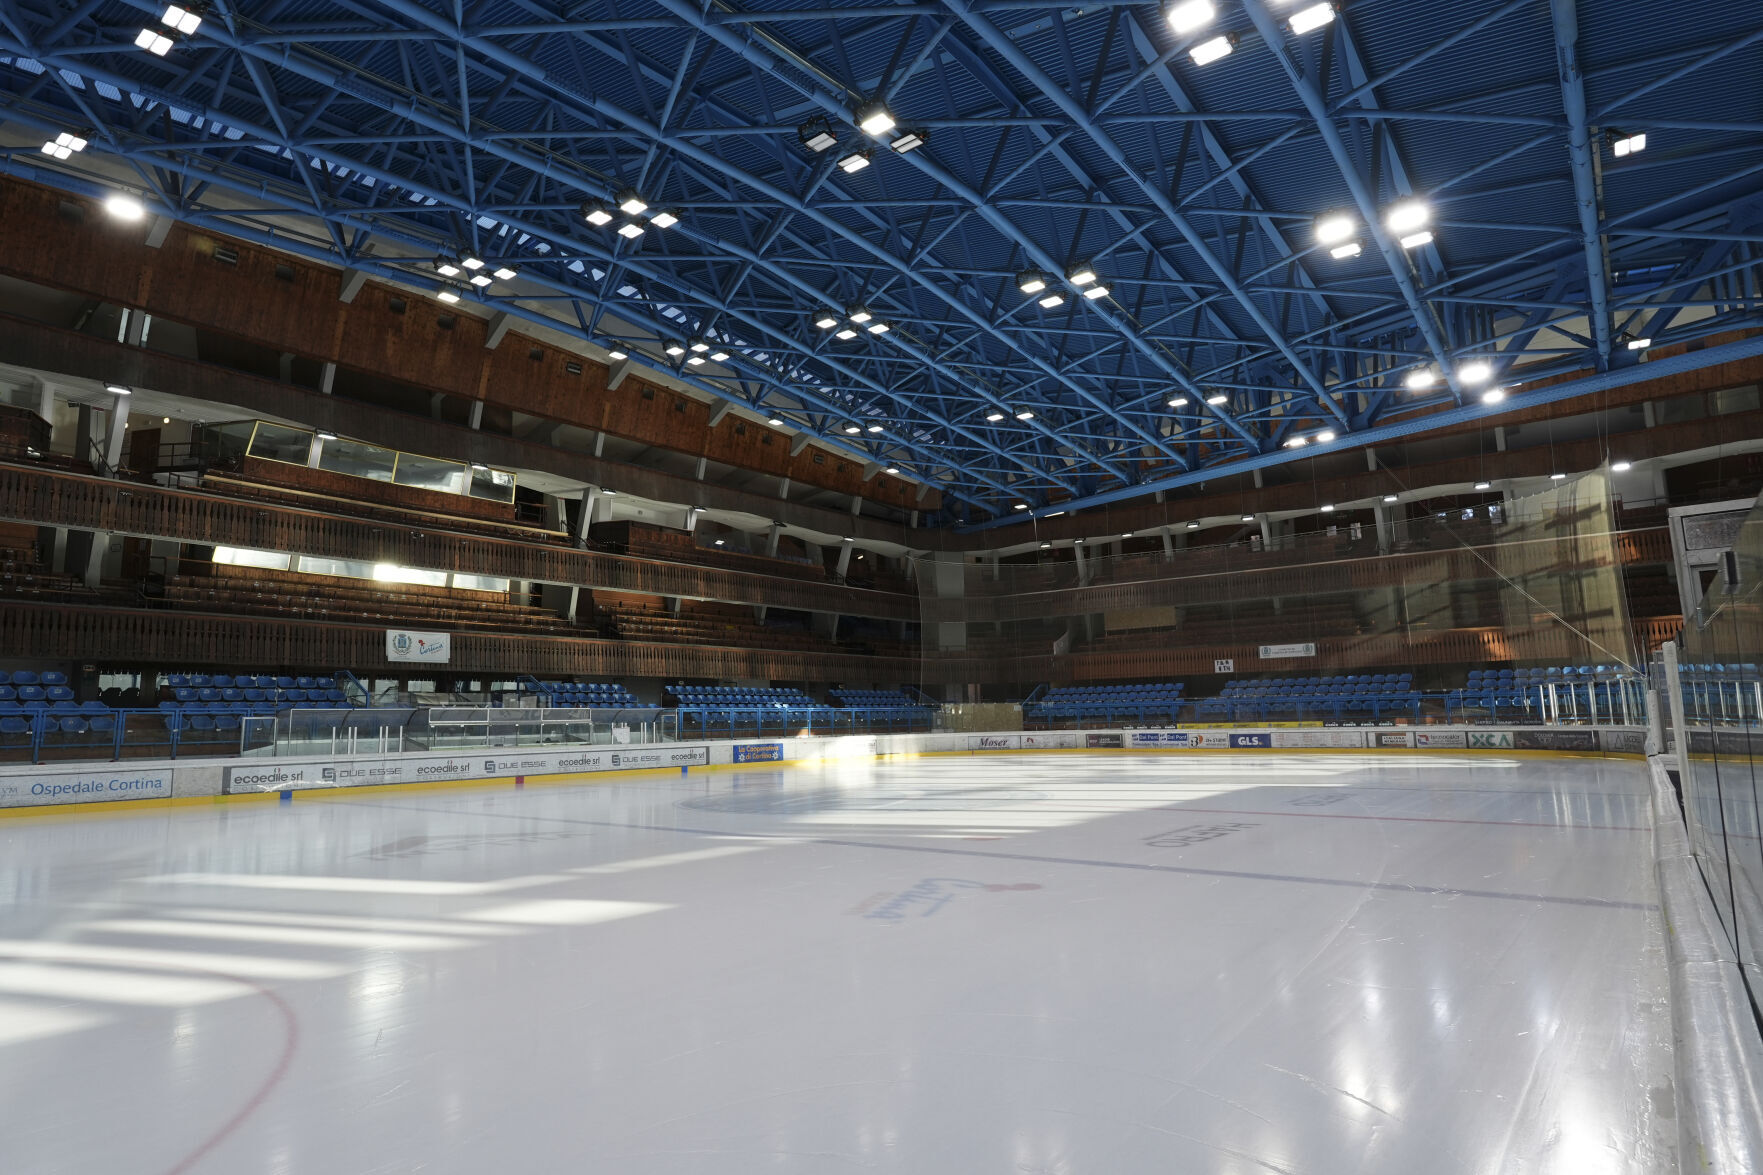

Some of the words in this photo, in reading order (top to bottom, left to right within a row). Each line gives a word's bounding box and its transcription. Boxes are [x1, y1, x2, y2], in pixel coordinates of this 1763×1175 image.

[979, 737, 1008, 747] Moser
[558, 754, 591, 767] ecoedile
[592, 756, 600, 765] srl
[622, 755, 638, 763] DUE
[641, 754, 662, 762] ESSE
[671, 749, 698, 761] ecoedile
[417, 760, 459, 774] ecoedile
[460, 763, 470, 772] srl
[498, 762, 518, 770] DUE
[521, 760, 546, 768] ESSE
[234, 767, 289, 784] ecoedile
[290, 770, 303, 781] srl
[339, 769, 366, 778] DUE
[369, 767, 403, 776] ESSE
[31, 780, 104, 797] Ospedale
[108, 777, 162, 791] Cortina
